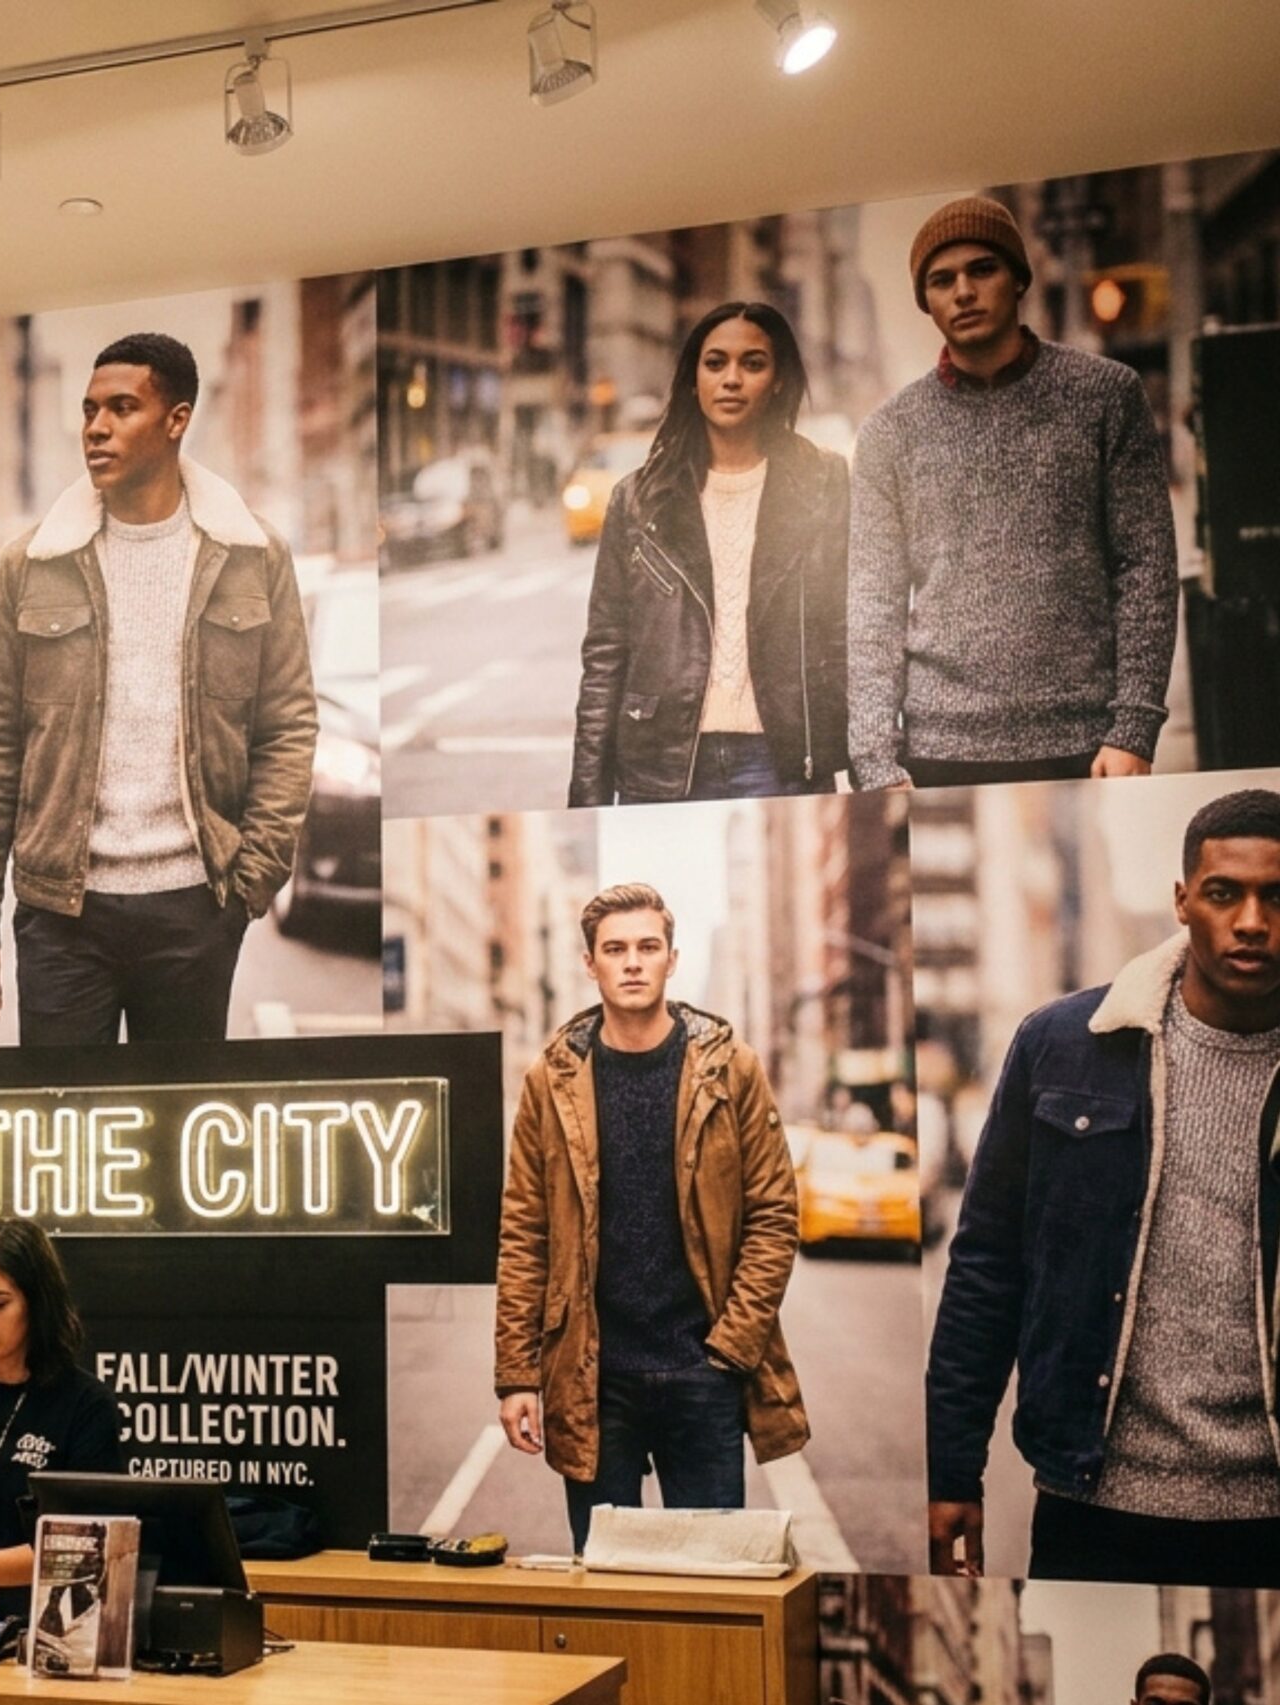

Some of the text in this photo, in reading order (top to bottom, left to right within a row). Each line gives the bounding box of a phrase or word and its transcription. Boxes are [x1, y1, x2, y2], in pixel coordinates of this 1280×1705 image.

[180, 1099, 423, 1218] CITY
[96, 1352, 340, 1397] FALL/WINTER
[128, 1456, 315, 1486] CAPTURED IN NYC.
